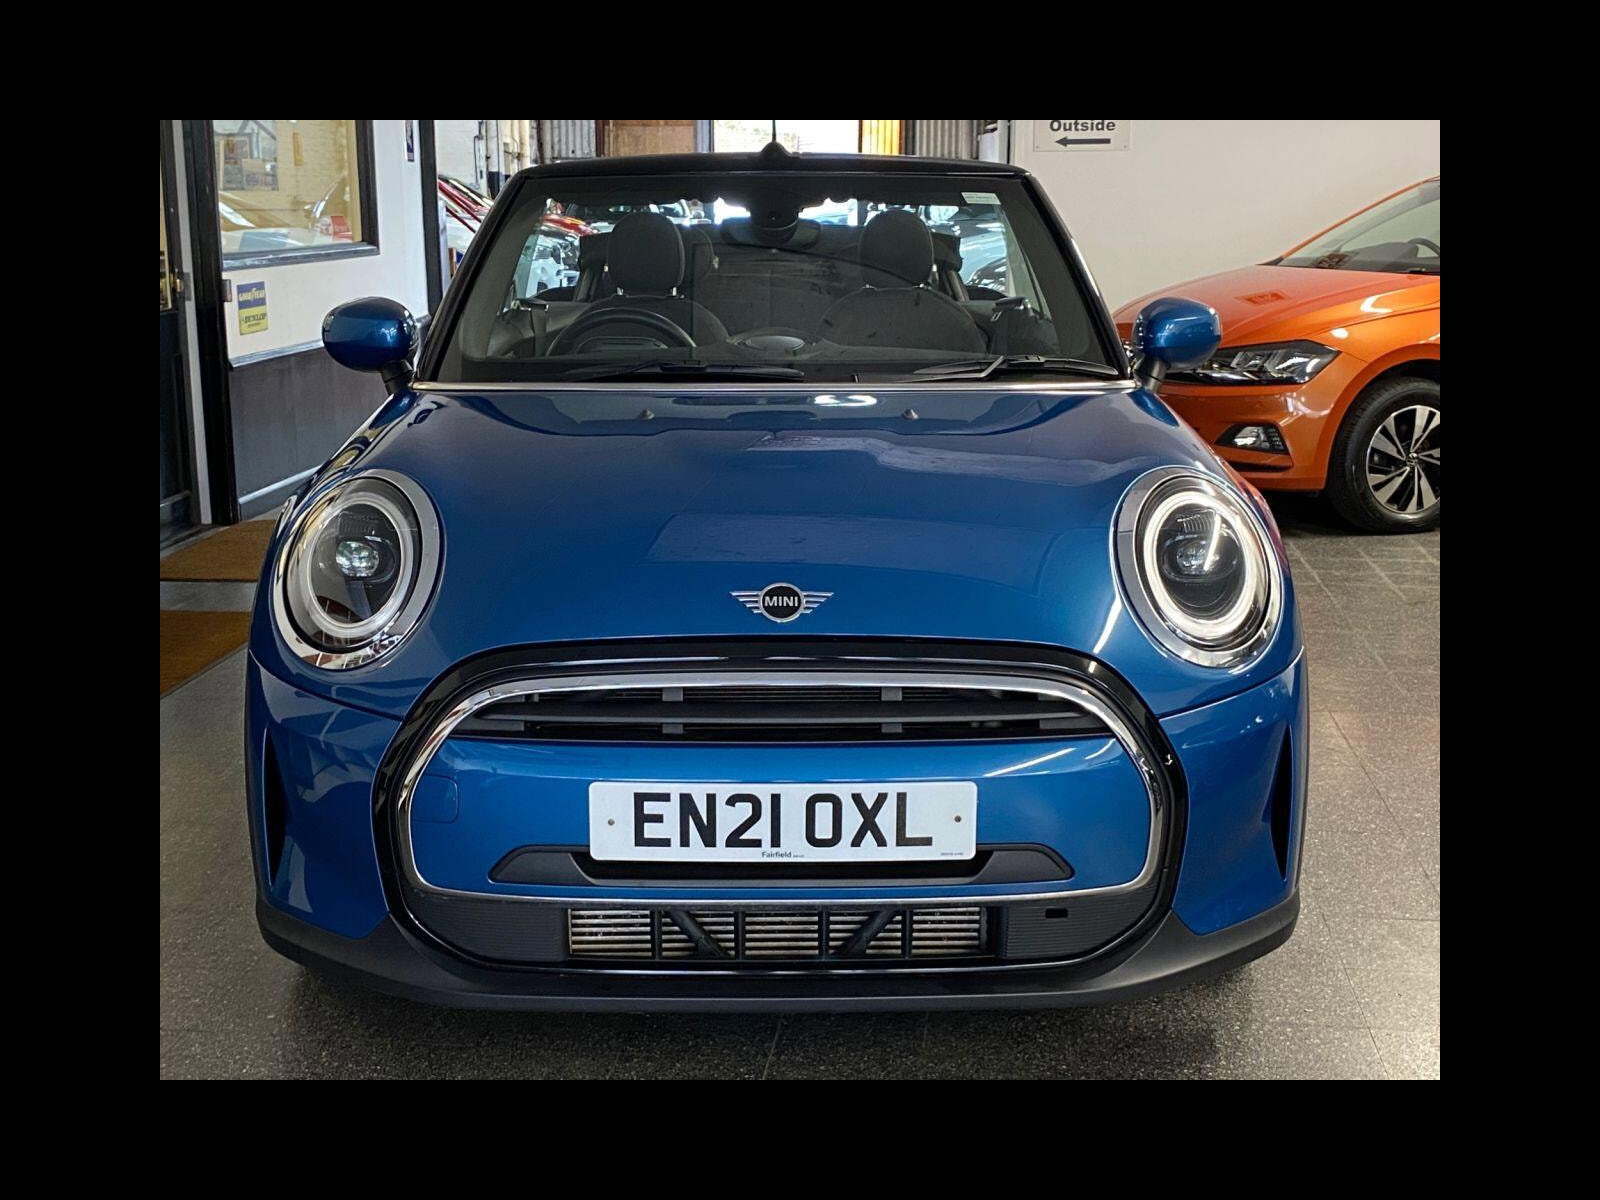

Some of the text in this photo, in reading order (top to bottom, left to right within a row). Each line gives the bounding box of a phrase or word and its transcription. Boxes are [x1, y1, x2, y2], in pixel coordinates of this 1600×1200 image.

[1049, 120, 1116, 132] Outside
[764, 596, 798, 607] MINI
[633, 792, 933, 848] EN21 OXL
